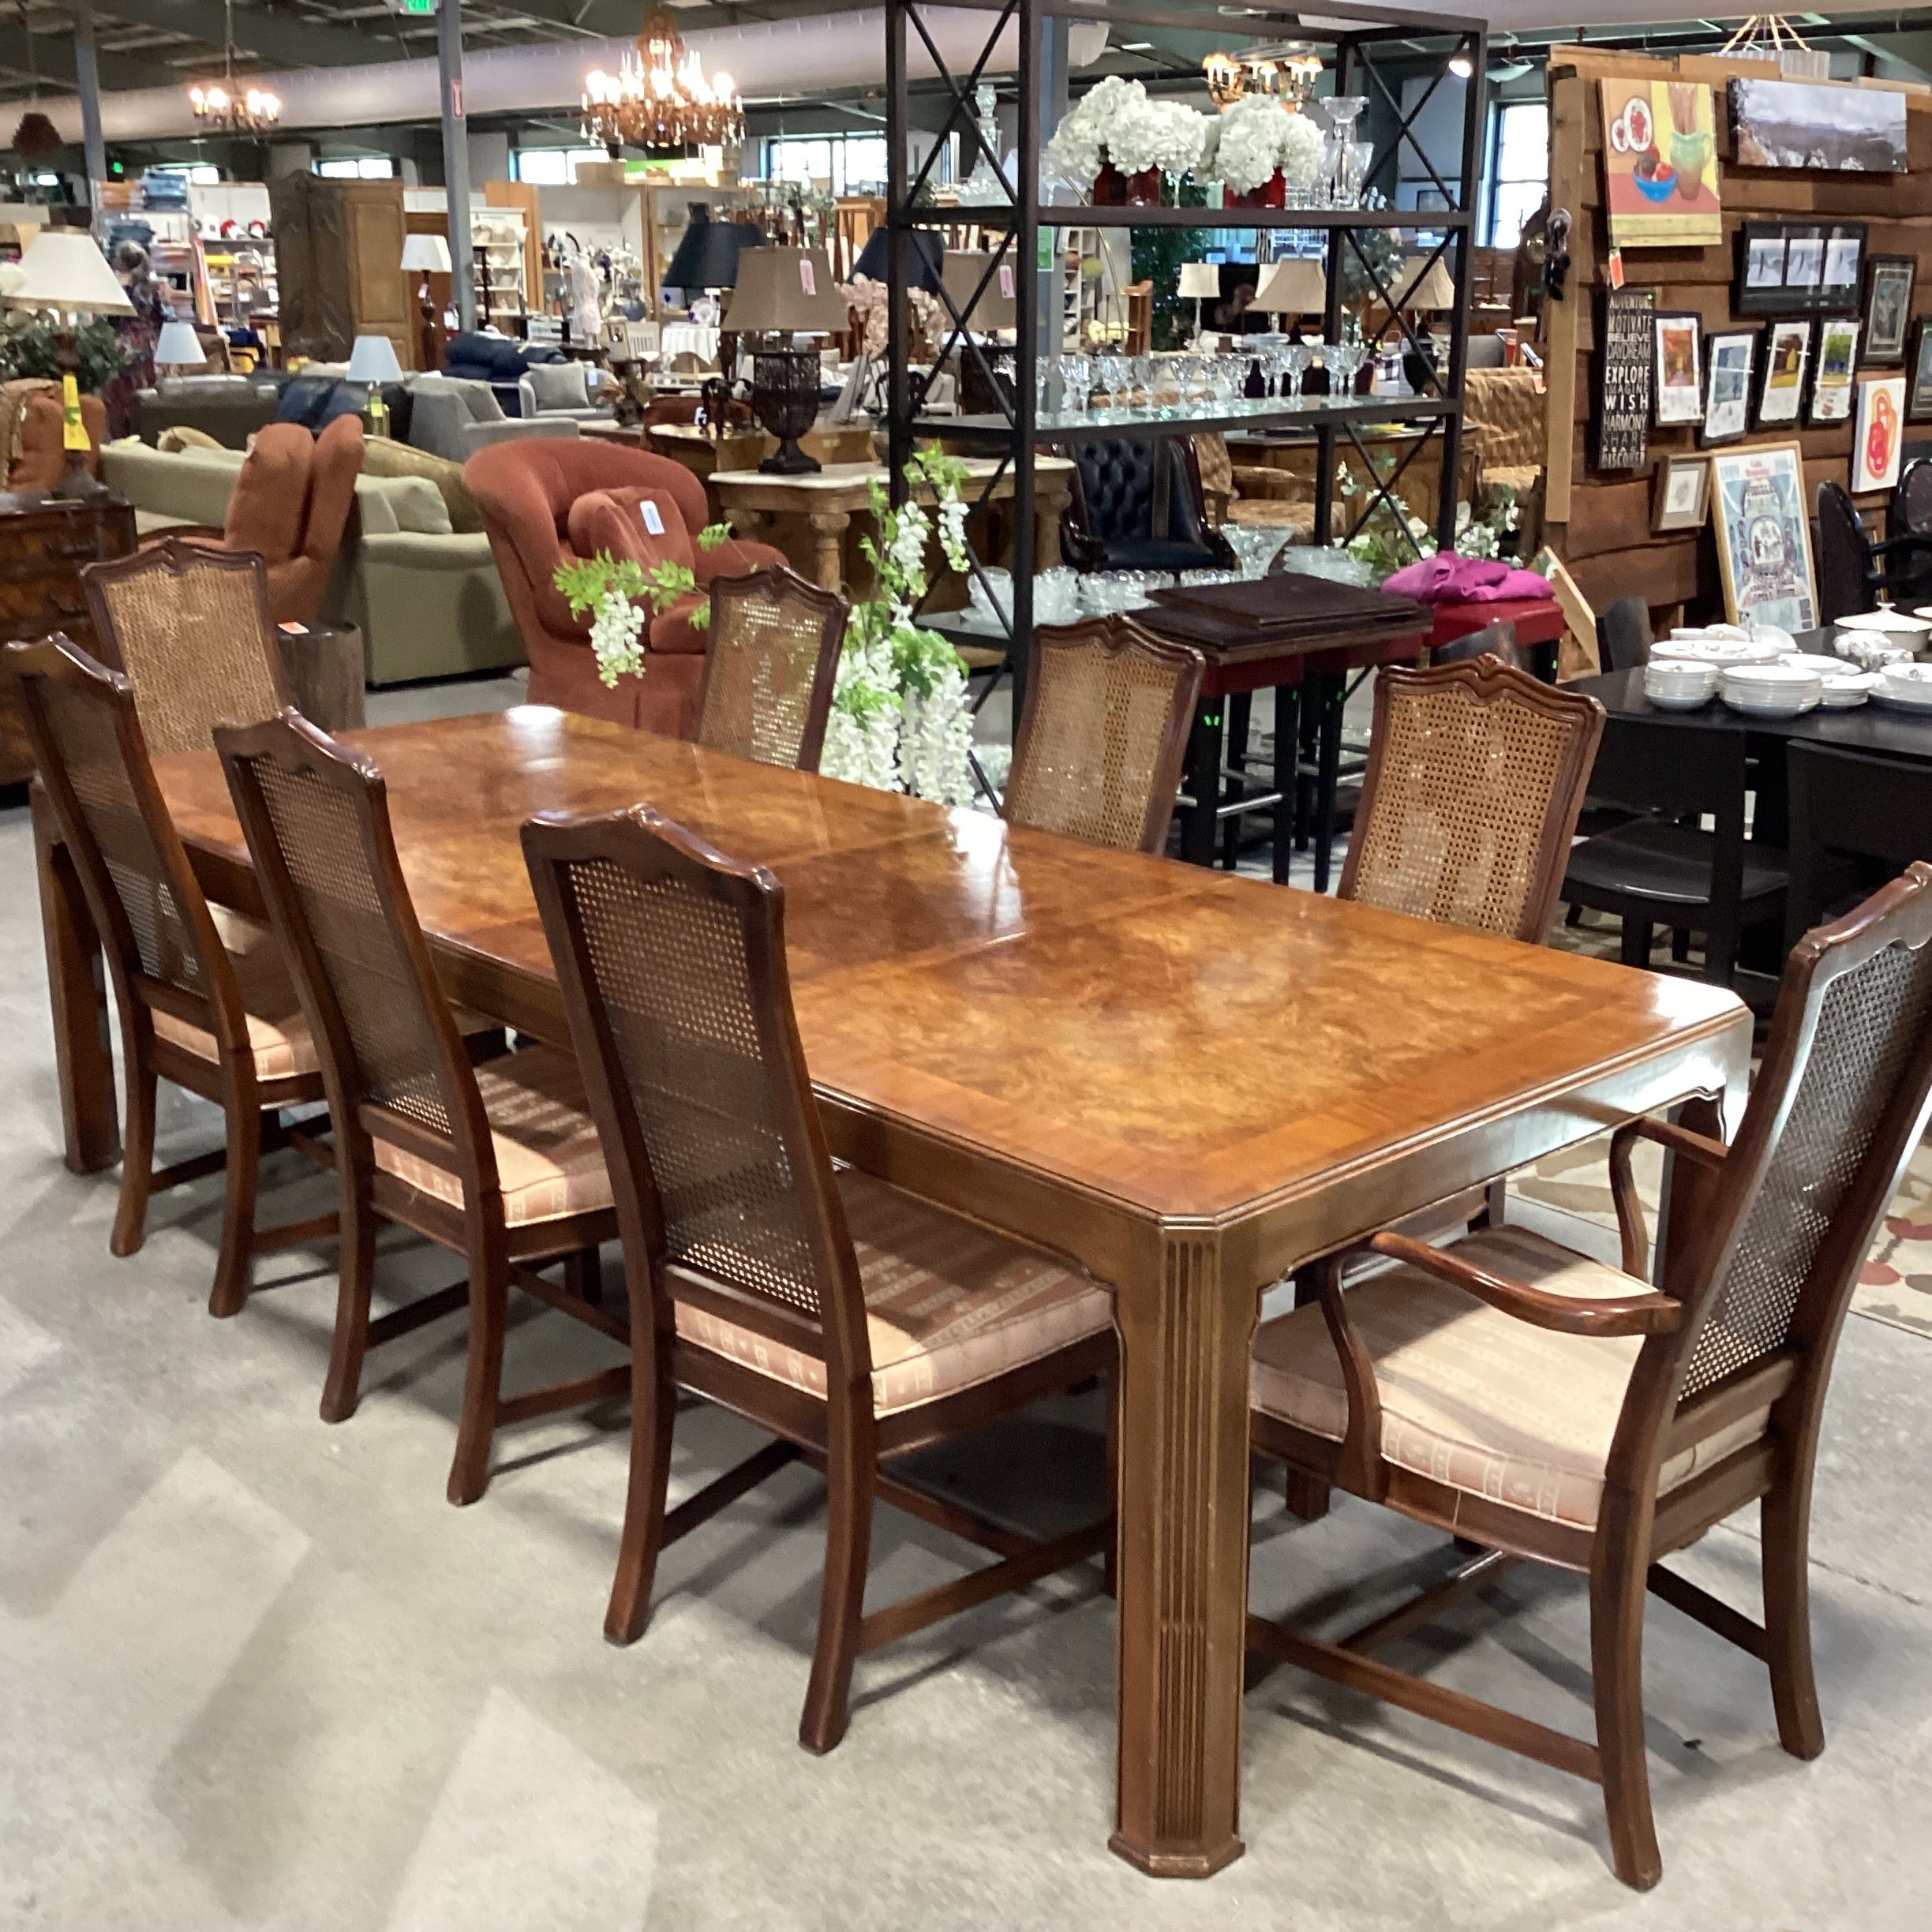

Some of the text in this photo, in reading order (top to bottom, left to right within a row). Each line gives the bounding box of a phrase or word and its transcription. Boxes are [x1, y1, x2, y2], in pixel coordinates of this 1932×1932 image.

[1608, 315, 1653, 332] MOTIVATE
[1608, 332, 1650, 342] BELIEVE
[1607, 342, 1651, 359] DAYDREAM
[1606, 365, 1649, 384] EXPLORE
[1604, 394, 1648, 410] WISH
[1603, 414, 1647, 431] HARMONY
[1603, 431, 1646, 444] SHARE
